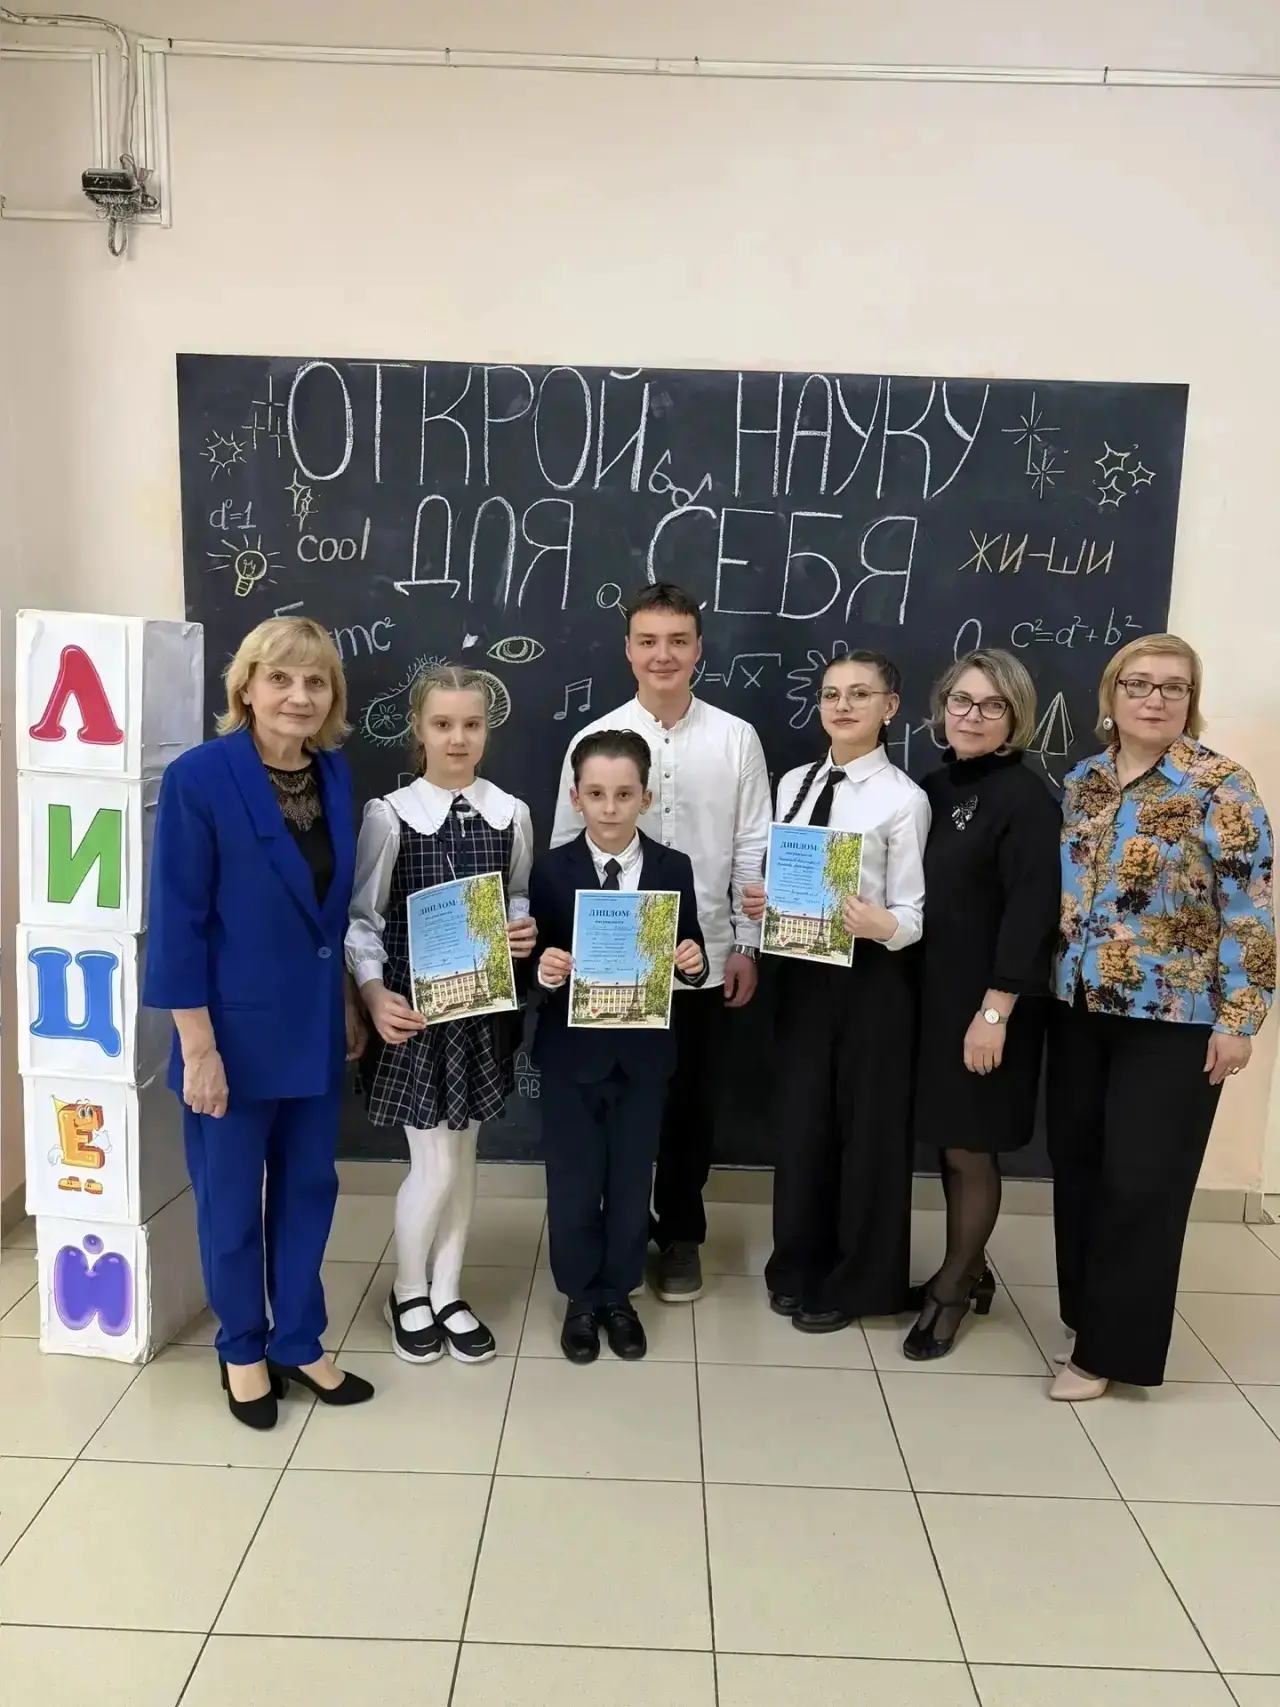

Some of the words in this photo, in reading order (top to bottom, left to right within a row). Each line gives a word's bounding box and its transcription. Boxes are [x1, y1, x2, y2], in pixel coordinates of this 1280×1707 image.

[287, 361, 652, 492] ОТКРОЙ
[733, 372, 991, 499] НАУКУ
[393, 494, 575, 611] ДЛЯ
[646, 505, 918, 625] СЕБЯ
[780, 841, 818, 851] ДИПЛОМ
[419, 899, 457, 915] ДИПЛОМ
[588, 909, 630, 917] ДИПЛОМ
